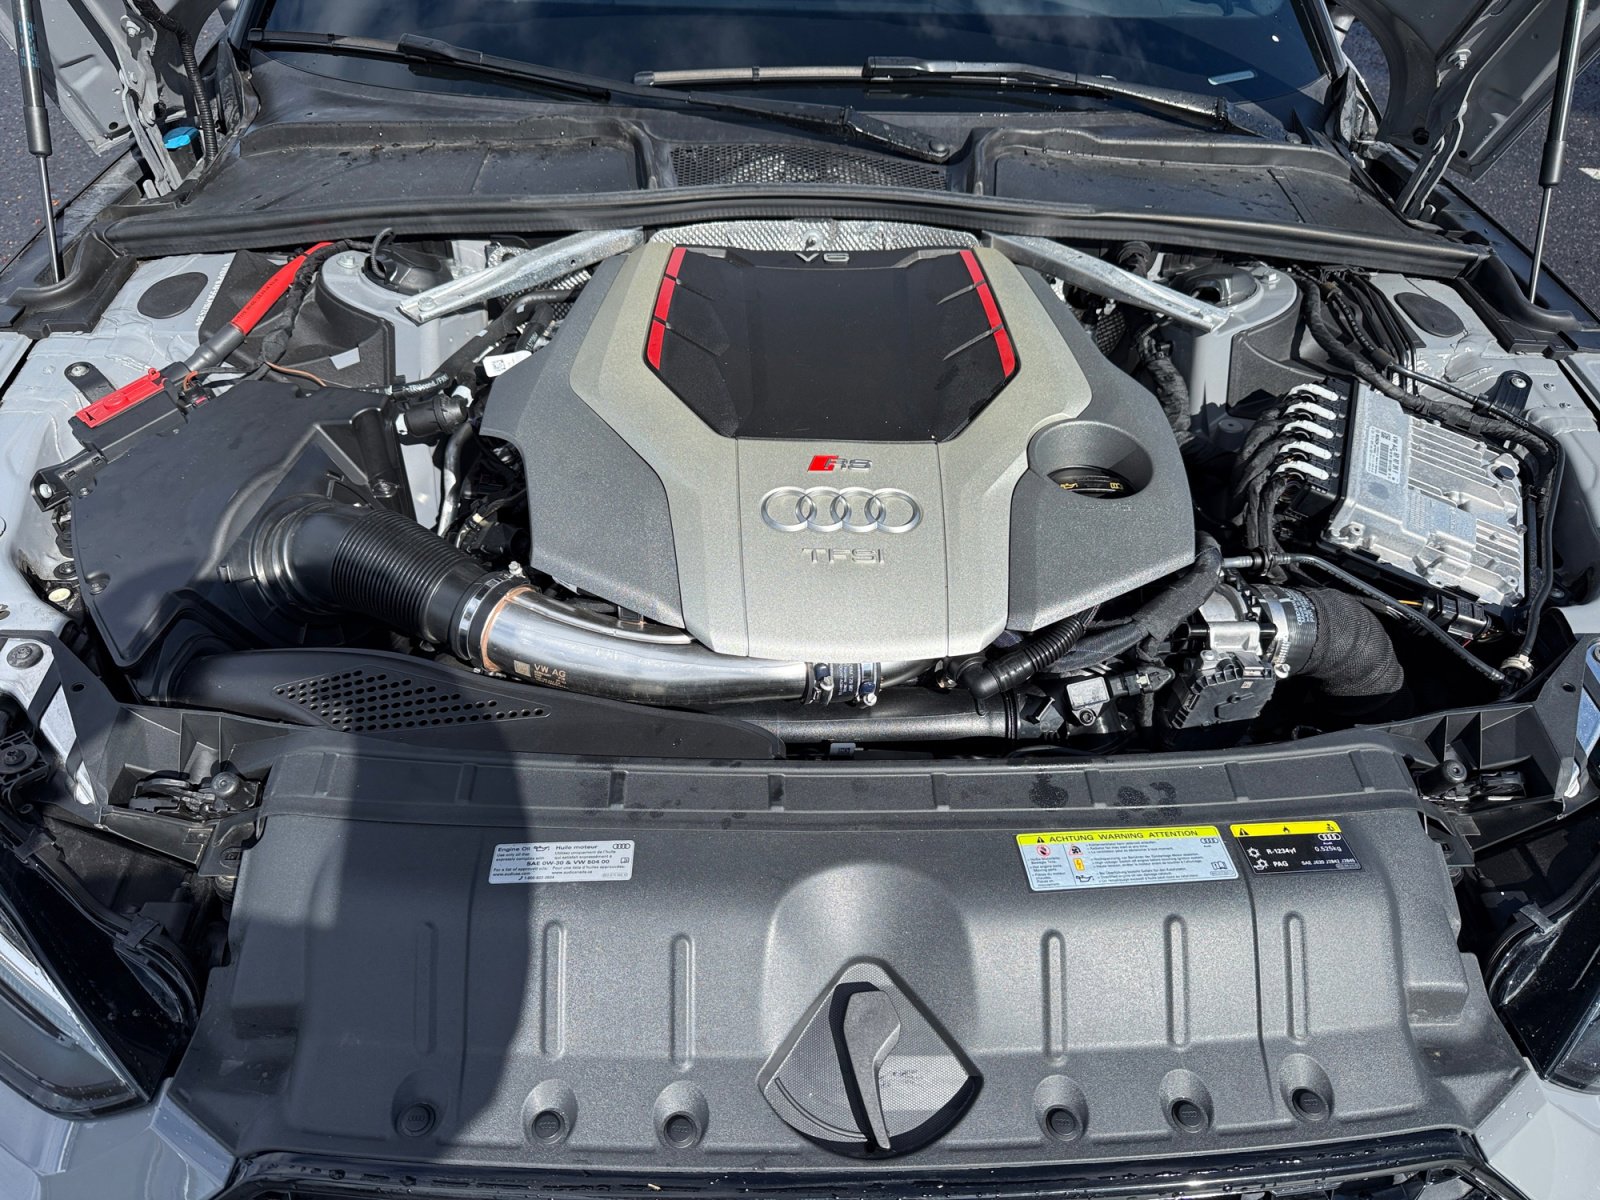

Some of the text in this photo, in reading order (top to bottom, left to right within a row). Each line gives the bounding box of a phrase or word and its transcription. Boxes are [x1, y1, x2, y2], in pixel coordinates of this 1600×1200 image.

[794, 252, 850, 262] V6
[812, 455, 872, 471] RS
[801, 548, 885, 564] TFSI
[534, 664, 566, 678] VW AG
[1050, 835, 1094, 843] ACHTUNG
[1149, 830, 1198, 838] ATTENTION
